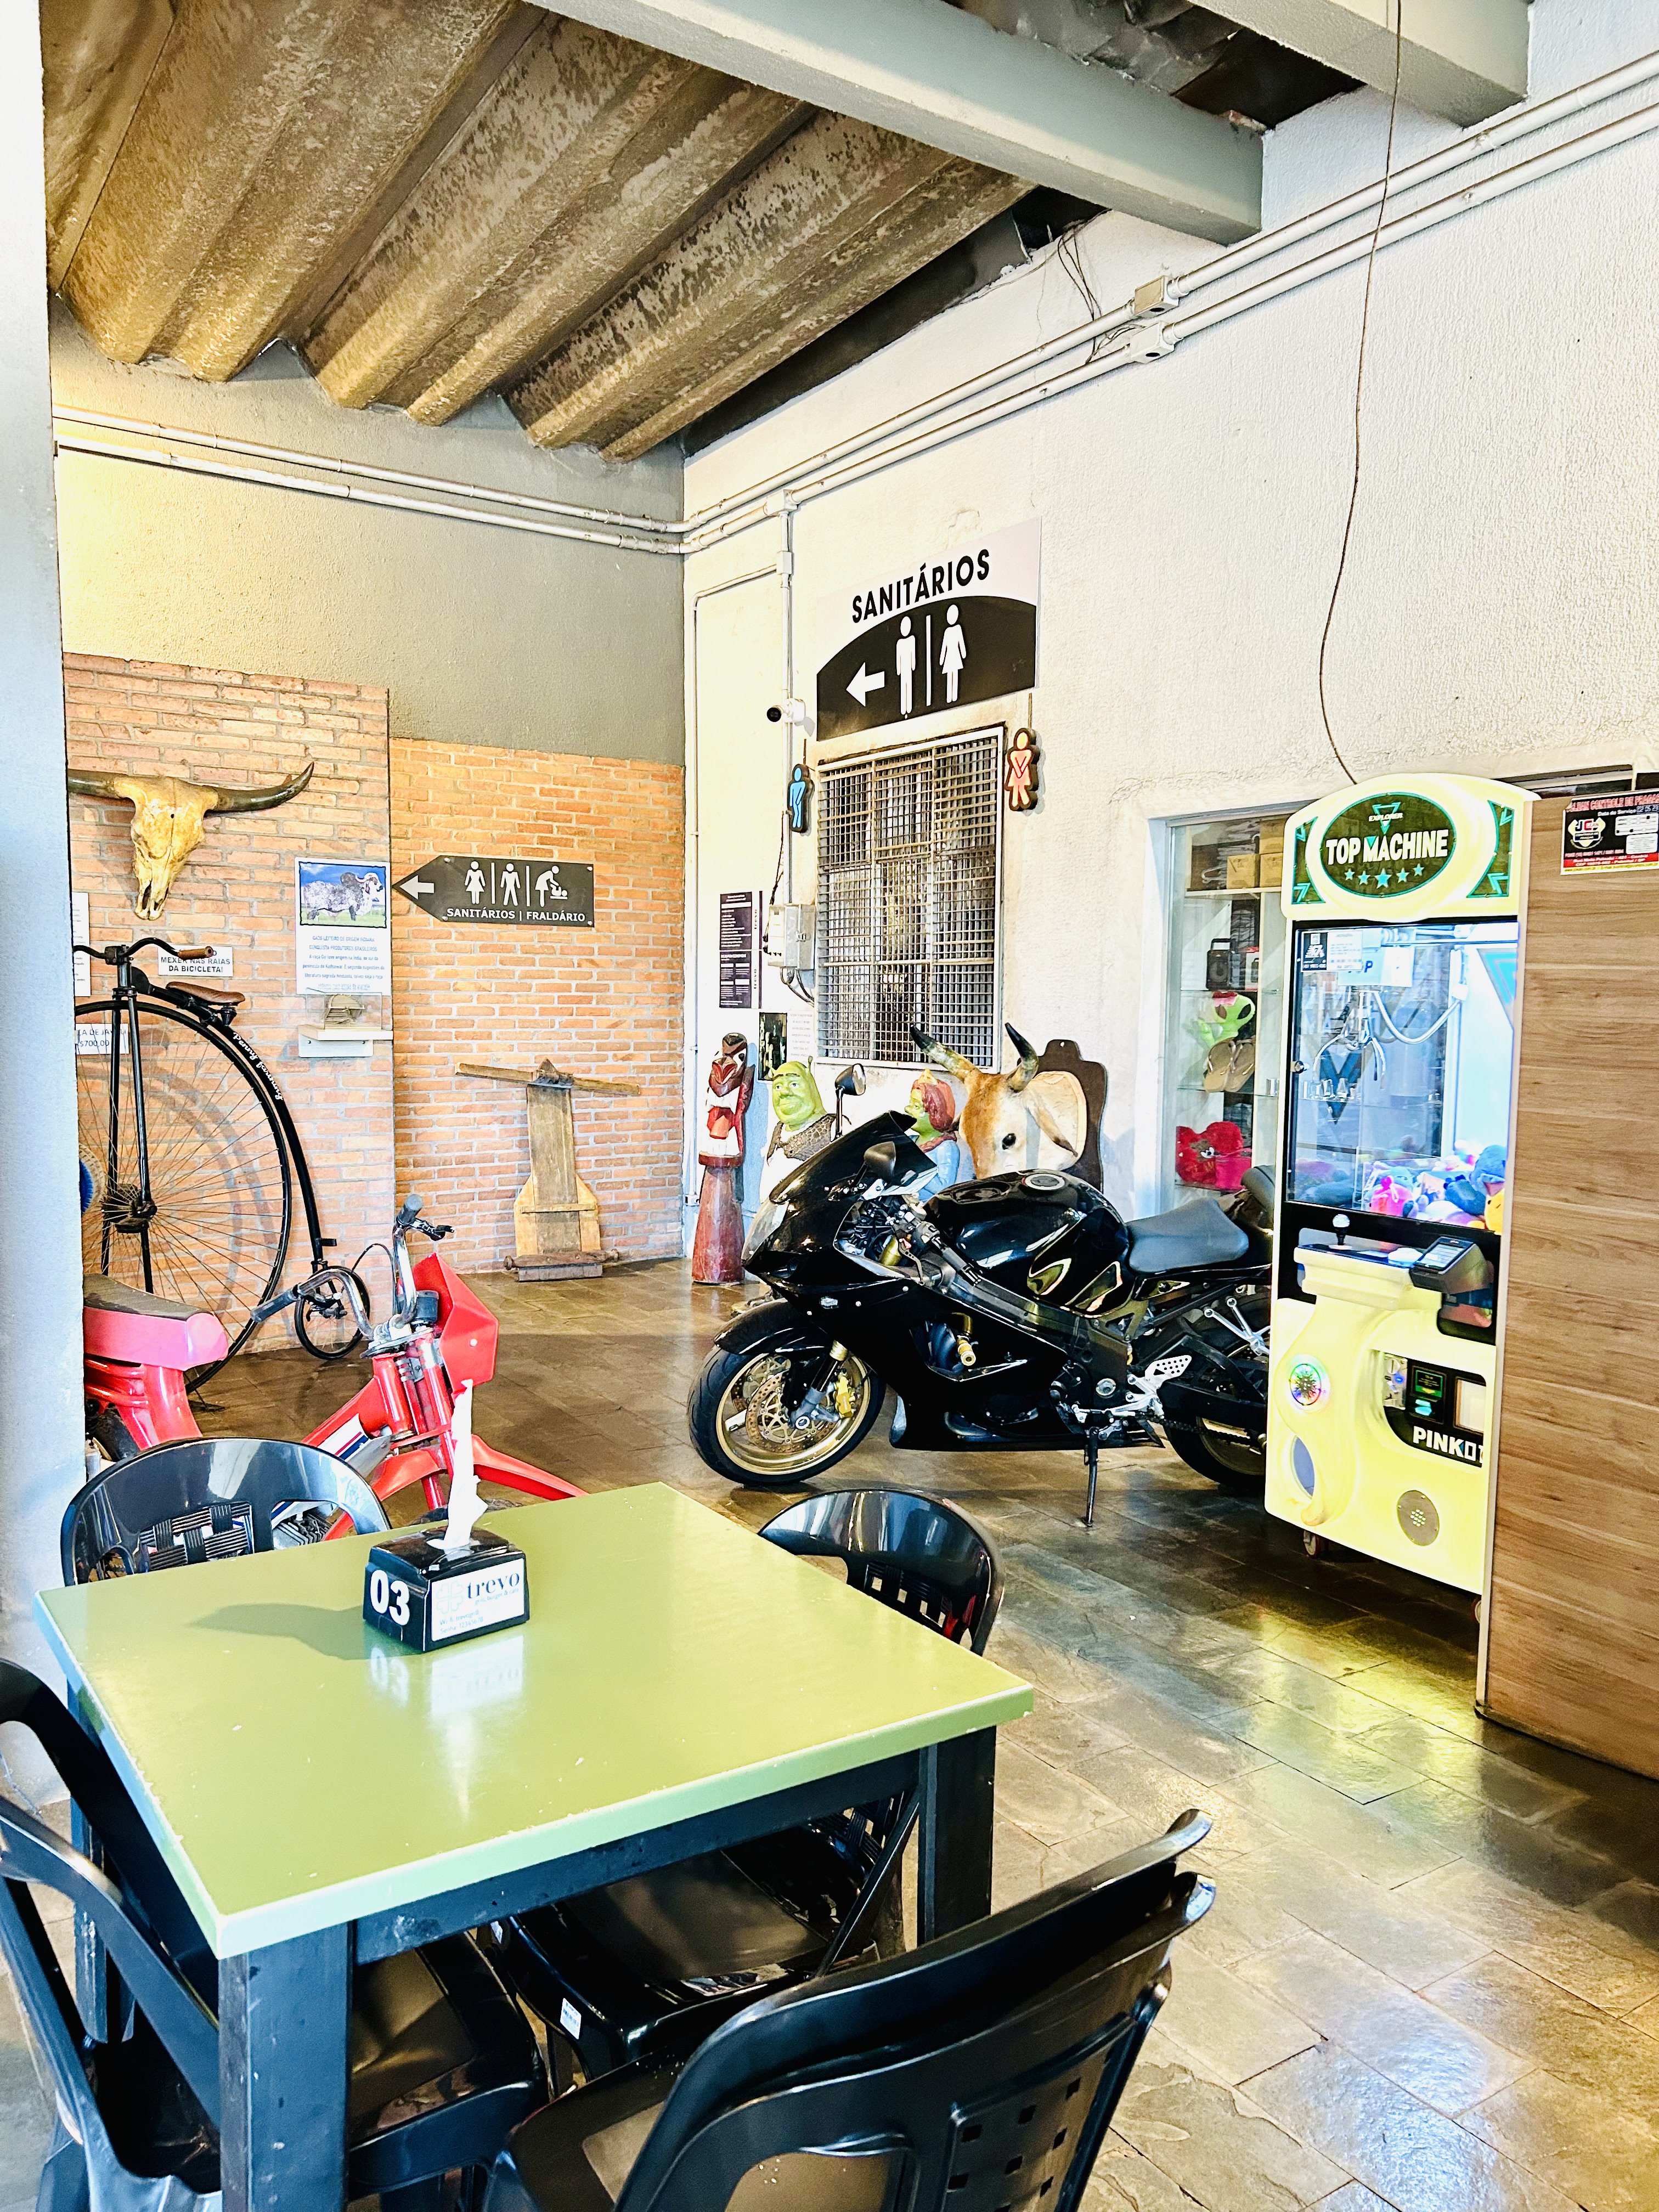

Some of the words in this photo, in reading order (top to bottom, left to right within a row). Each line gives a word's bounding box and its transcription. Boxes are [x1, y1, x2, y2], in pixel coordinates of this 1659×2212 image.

[852, 549, 990, 623] SANITÁRIOS
[1325, 837, 1361, 865] TOP
[1363, 829, 1449, 862] MACHINE
[447, 907, 516, 919] SANITÁRIOS
[526, 910, 585, 922] FRALDÁRIO
[233, 1032, 259, 1060] Penny
[370, 1570, 410, 1626] 03
[467, 1573, 520, 1599] trevo
